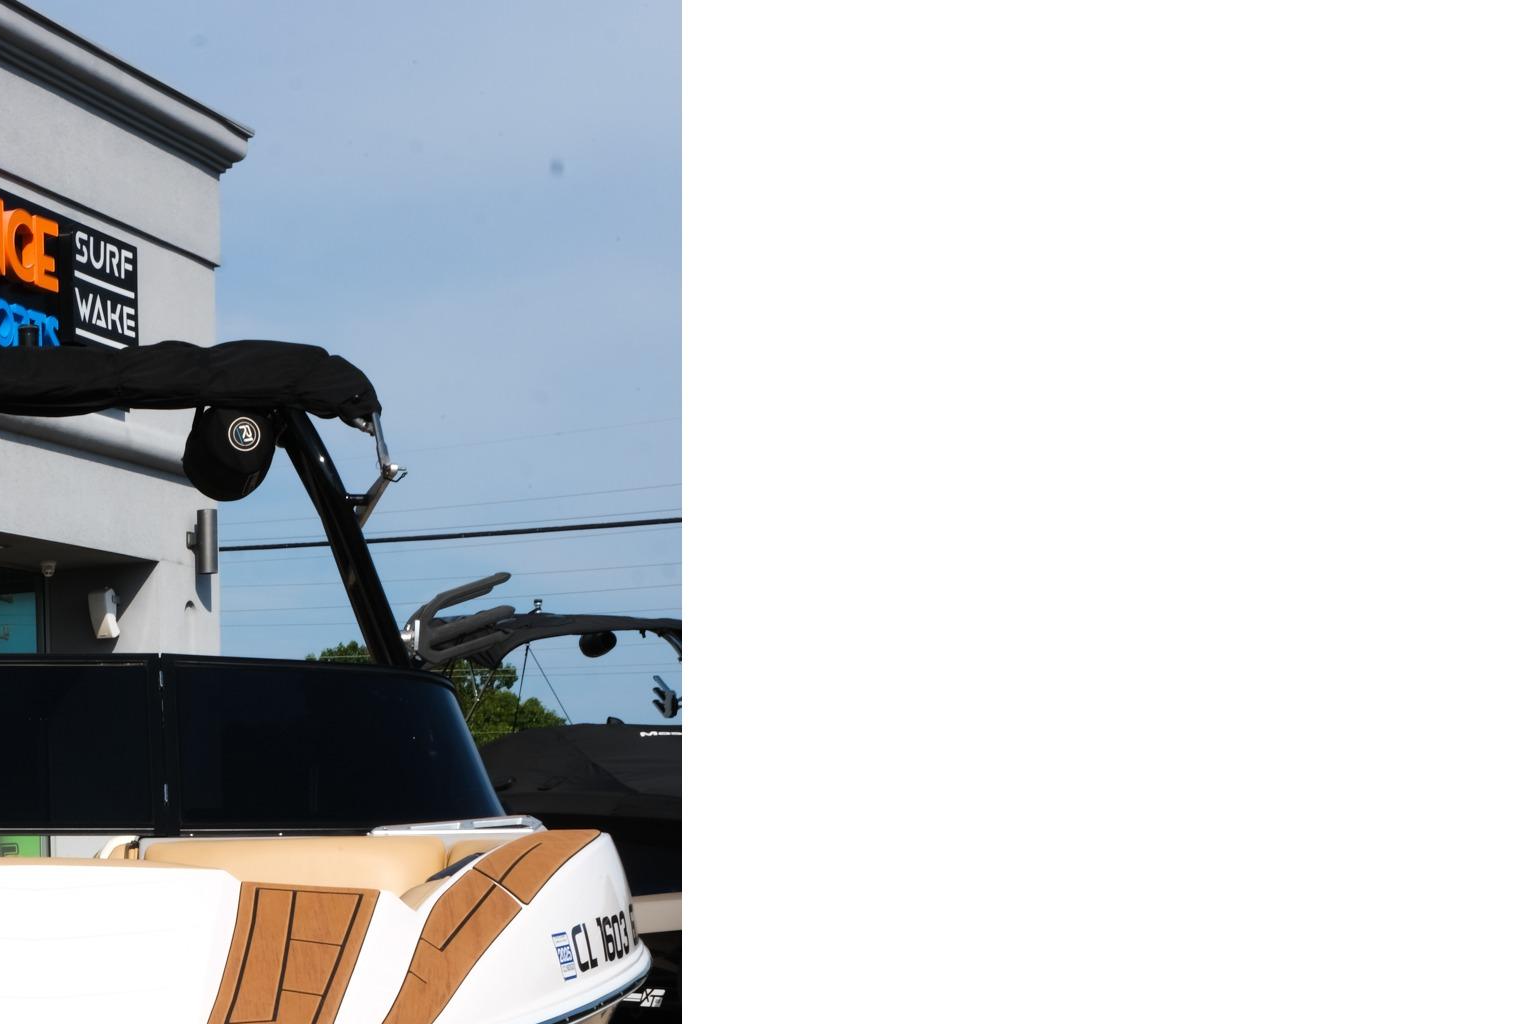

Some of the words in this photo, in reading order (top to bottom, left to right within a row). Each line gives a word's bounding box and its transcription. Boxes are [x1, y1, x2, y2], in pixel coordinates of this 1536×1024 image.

[75, 230, 134, 280] SURF
[74, 286, 136, 338] WAKE
[571, 922, 599, 972] CL
[596, 910, 630, 962] 1603
